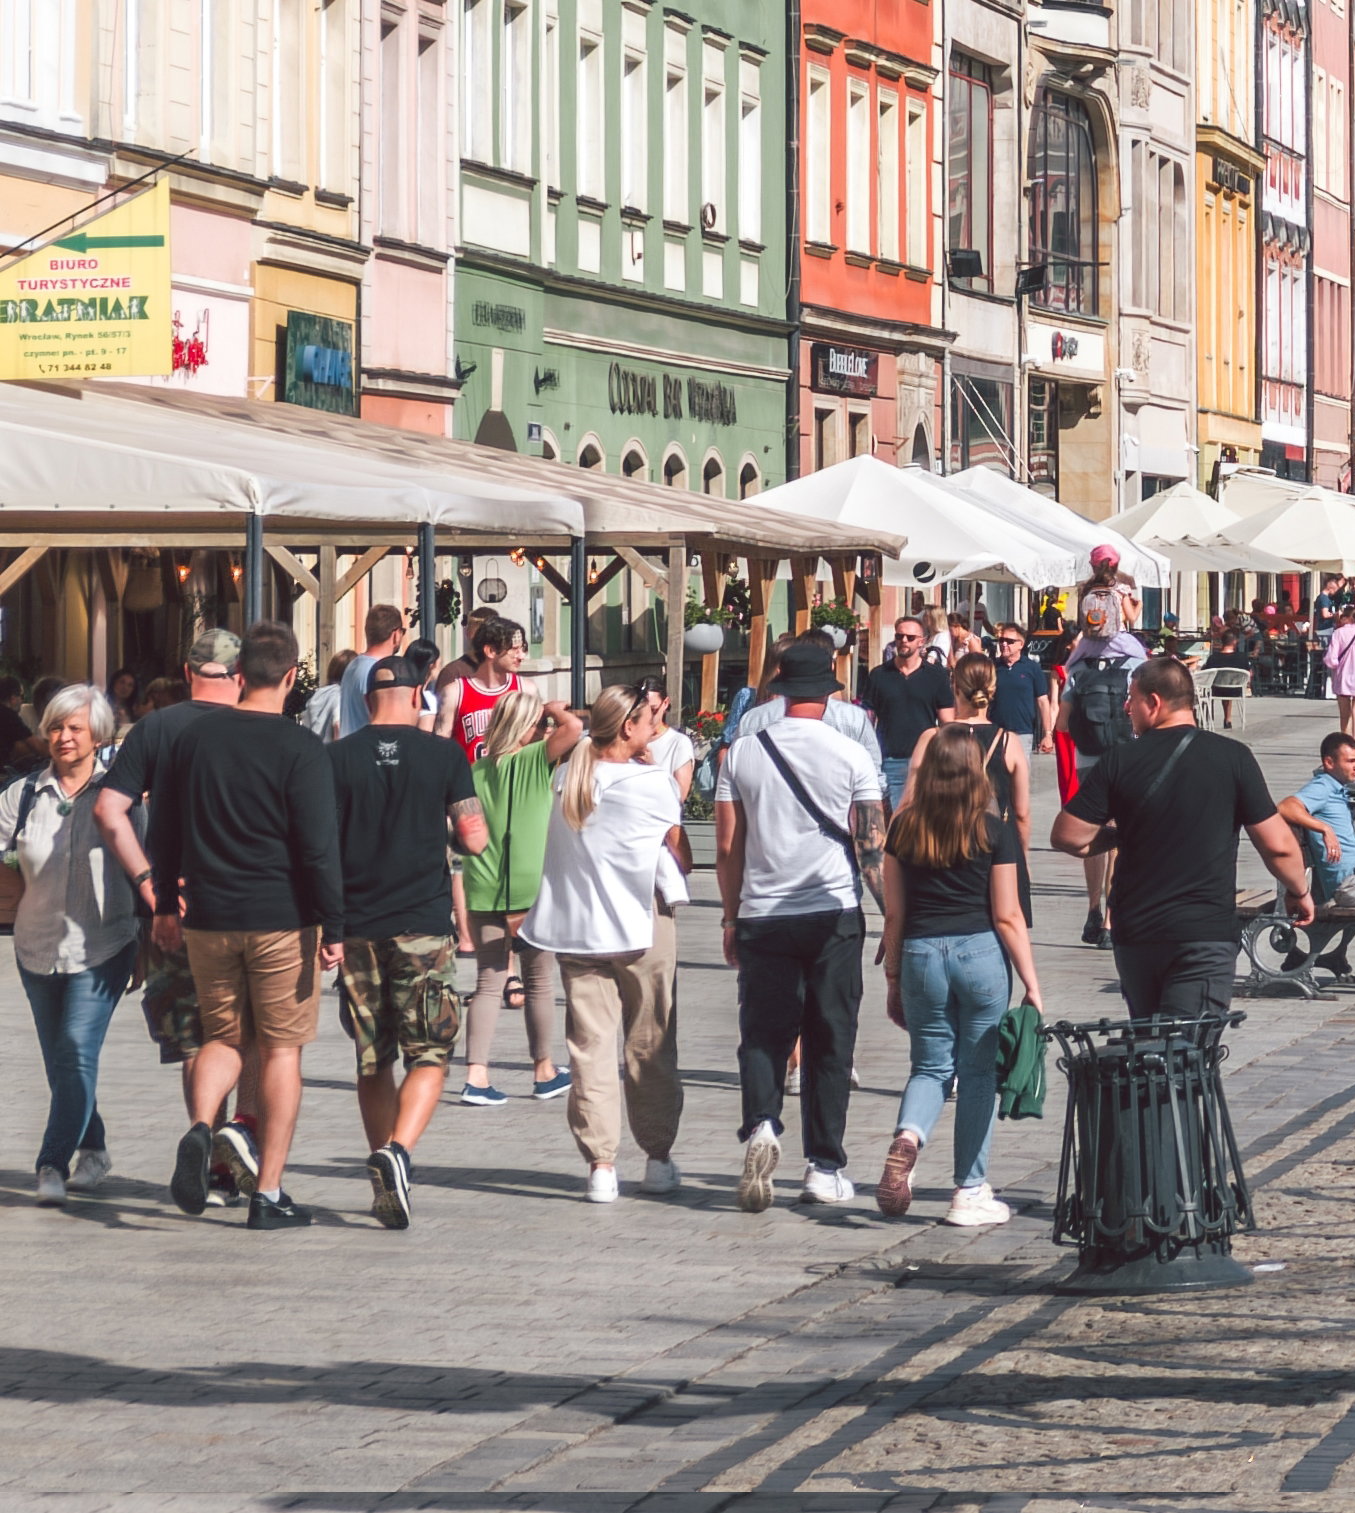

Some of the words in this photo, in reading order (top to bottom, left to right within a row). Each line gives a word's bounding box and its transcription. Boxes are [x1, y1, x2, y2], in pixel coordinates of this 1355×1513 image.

[50, 259, 98, 271] BIURO
[17, 277, 131, 290] TURYSTYCZNE
[48, 364, 59, 372] 71
